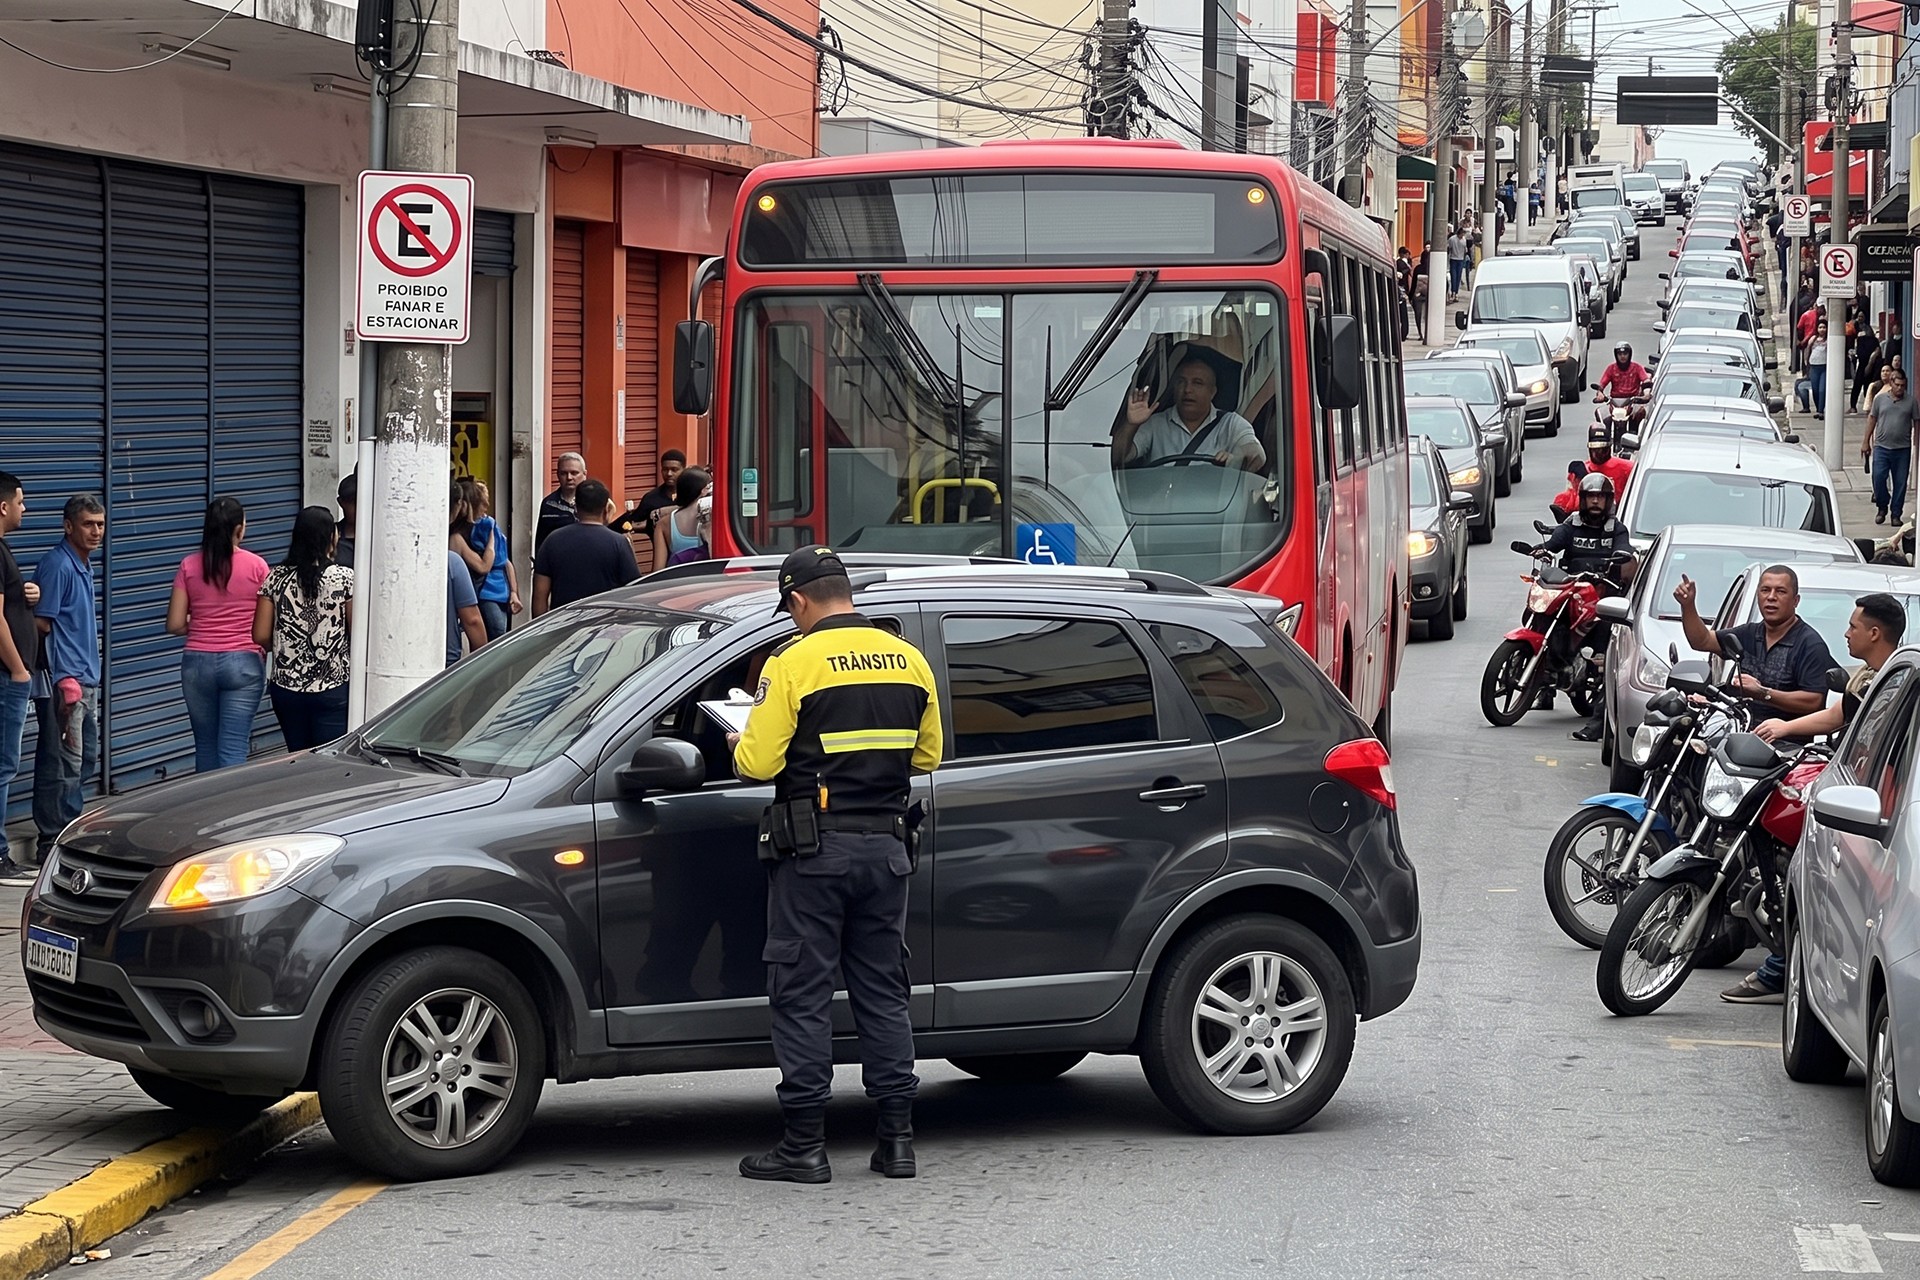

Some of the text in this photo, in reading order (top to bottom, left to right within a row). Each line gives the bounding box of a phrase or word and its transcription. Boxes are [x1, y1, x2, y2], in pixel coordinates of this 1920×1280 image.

[378, 284, 448, 297] PROIBIDO
[385, 300, 445, 313] FANAR E
[366, 316, 459, 330] ESTACIONAR
[826, 651, 907, 672] TRÂNSITO
